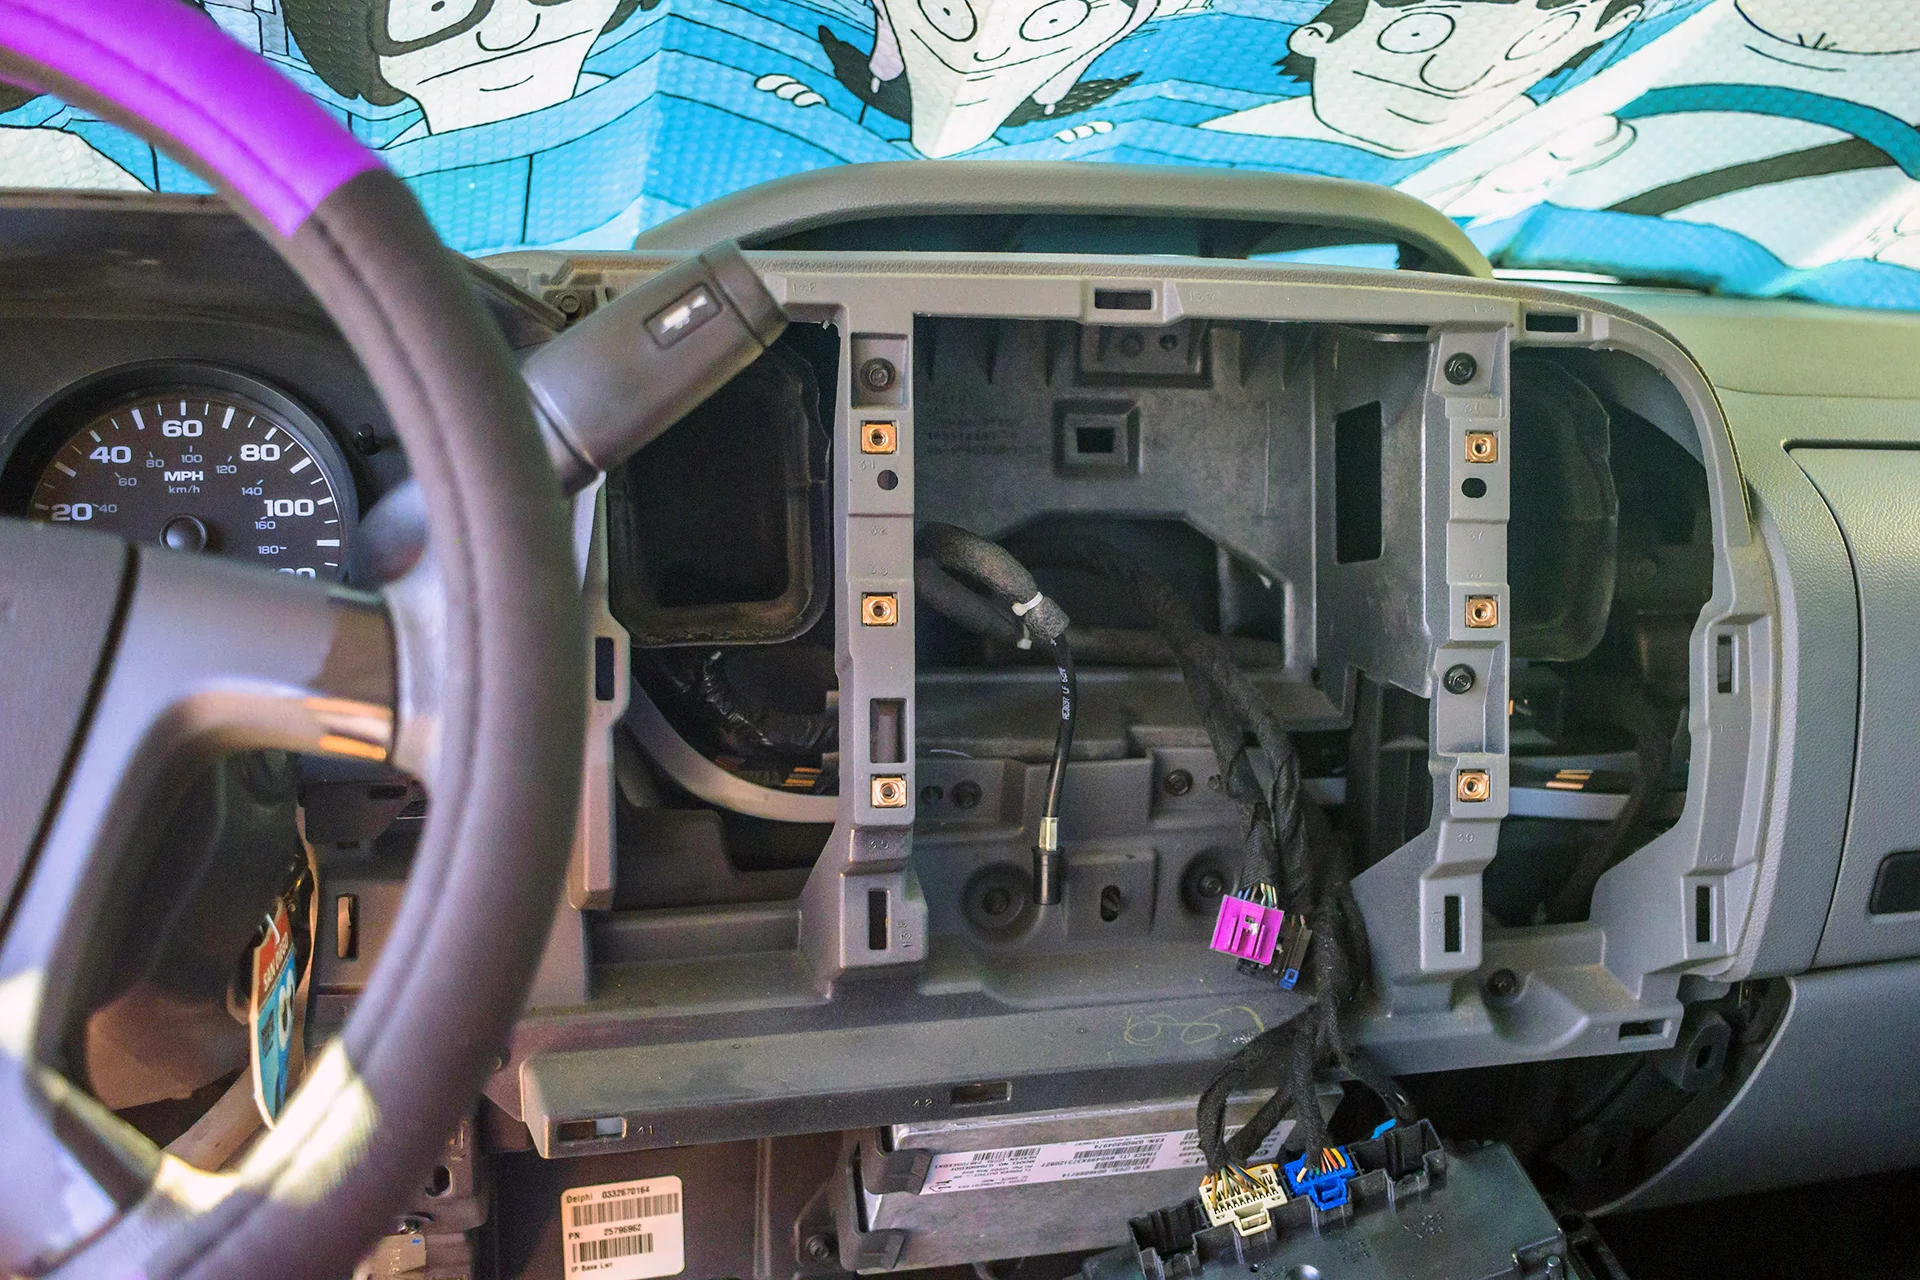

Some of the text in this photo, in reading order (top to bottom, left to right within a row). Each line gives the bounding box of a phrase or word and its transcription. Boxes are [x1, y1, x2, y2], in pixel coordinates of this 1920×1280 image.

[162, 420, 203, 437] 60
[89, 446, 132, 463] 40
[240, 444, 281, 461] 80
[181, 453, 203, 463] 100
[146, 459, 164, 468] 80
[215, 465, 237, 474] 120
[118, 477, 137, 486] 60
[164, 471, 204, 482] MPH
[168, 485, 200, 494] km/h
[241, 486, 263, 496] 140
[51, 503, 94, 521] 20
[99, 504, 118, 513] 40
[264, 499, 314, 517] 100
[254, 520, 276, 530] 160
[258, 545, 279, 554] 180
[263, 959, 276, 992] SAN
[566, 1193, 593, 1204] Delphi
